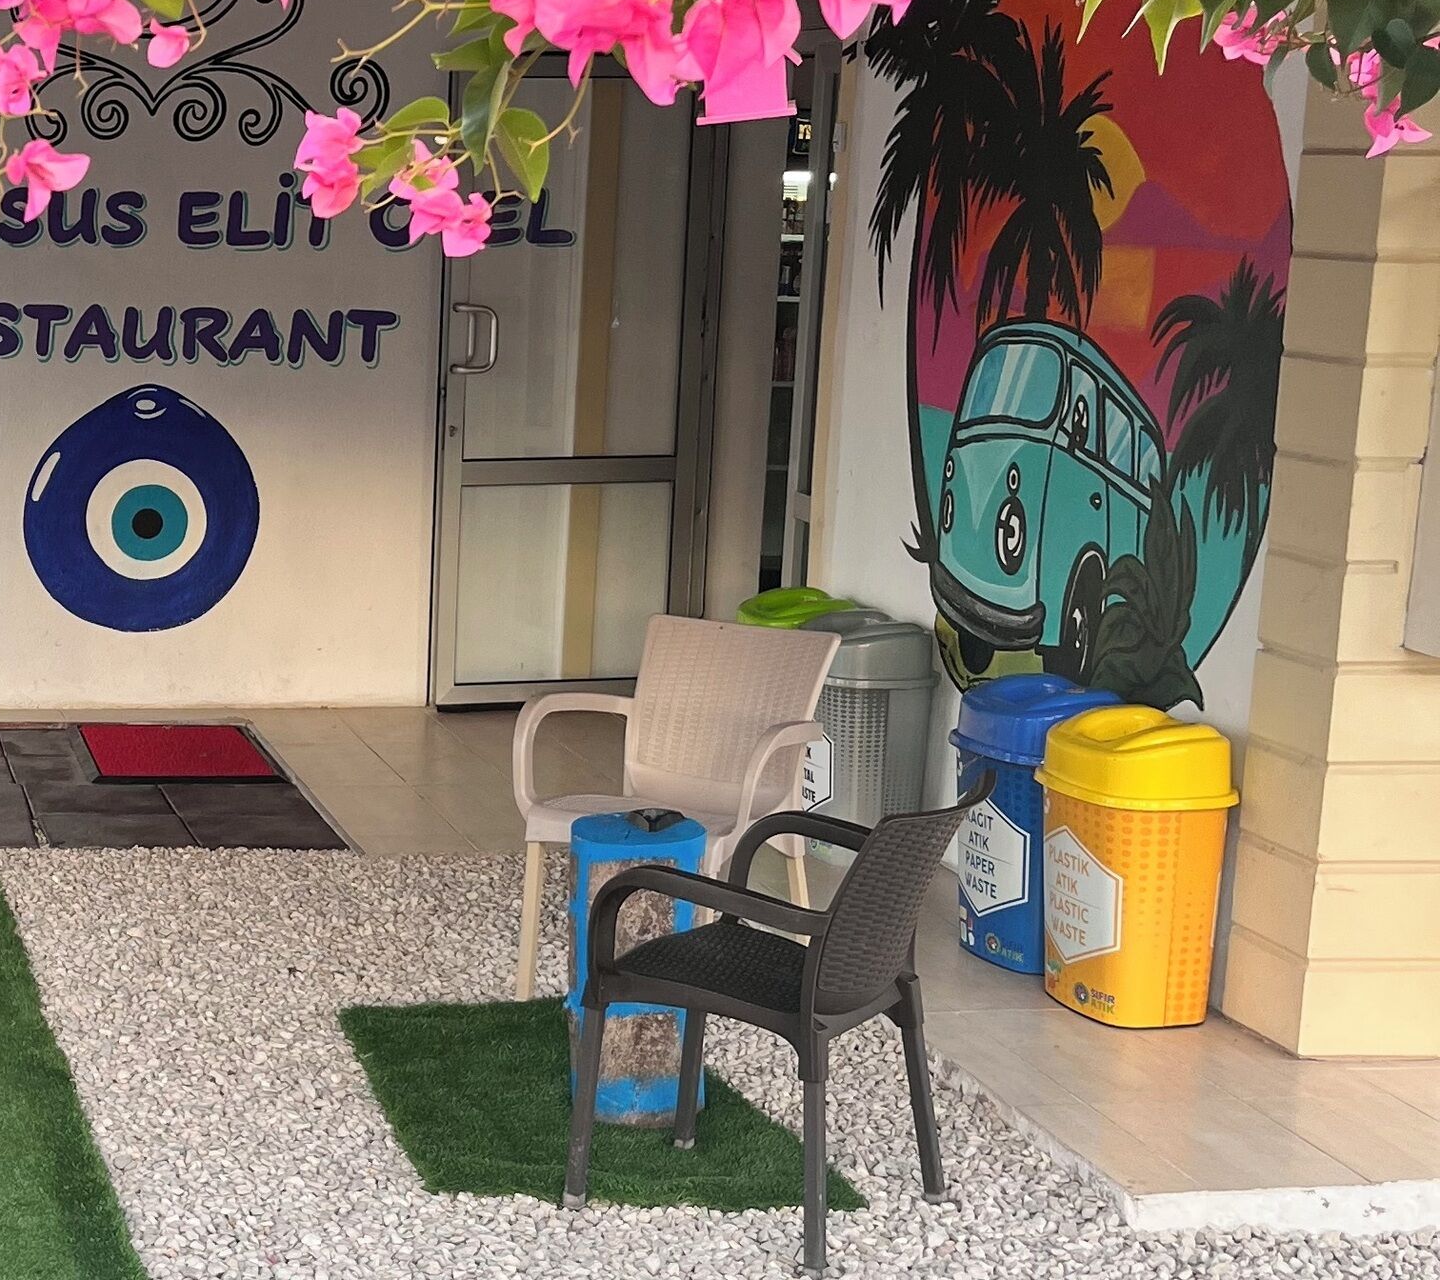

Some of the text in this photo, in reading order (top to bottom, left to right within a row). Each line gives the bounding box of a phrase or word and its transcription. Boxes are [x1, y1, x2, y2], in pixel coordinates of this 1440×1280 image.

[369, 188, 577, 251] OEL
[803, 767, 815, 784] TAL
[802, 785, 816, 803] STE
[969, 830, 990, 852] ATIK
[965, 851, 995, 877] PAPER
[965, 871, 998, 899] WASTE
[1055, 872, 1079, 896] ATIK
[1049, 891, 1090, 924] PLASTIC
[1052, 914, 1087, 947] WASTE
